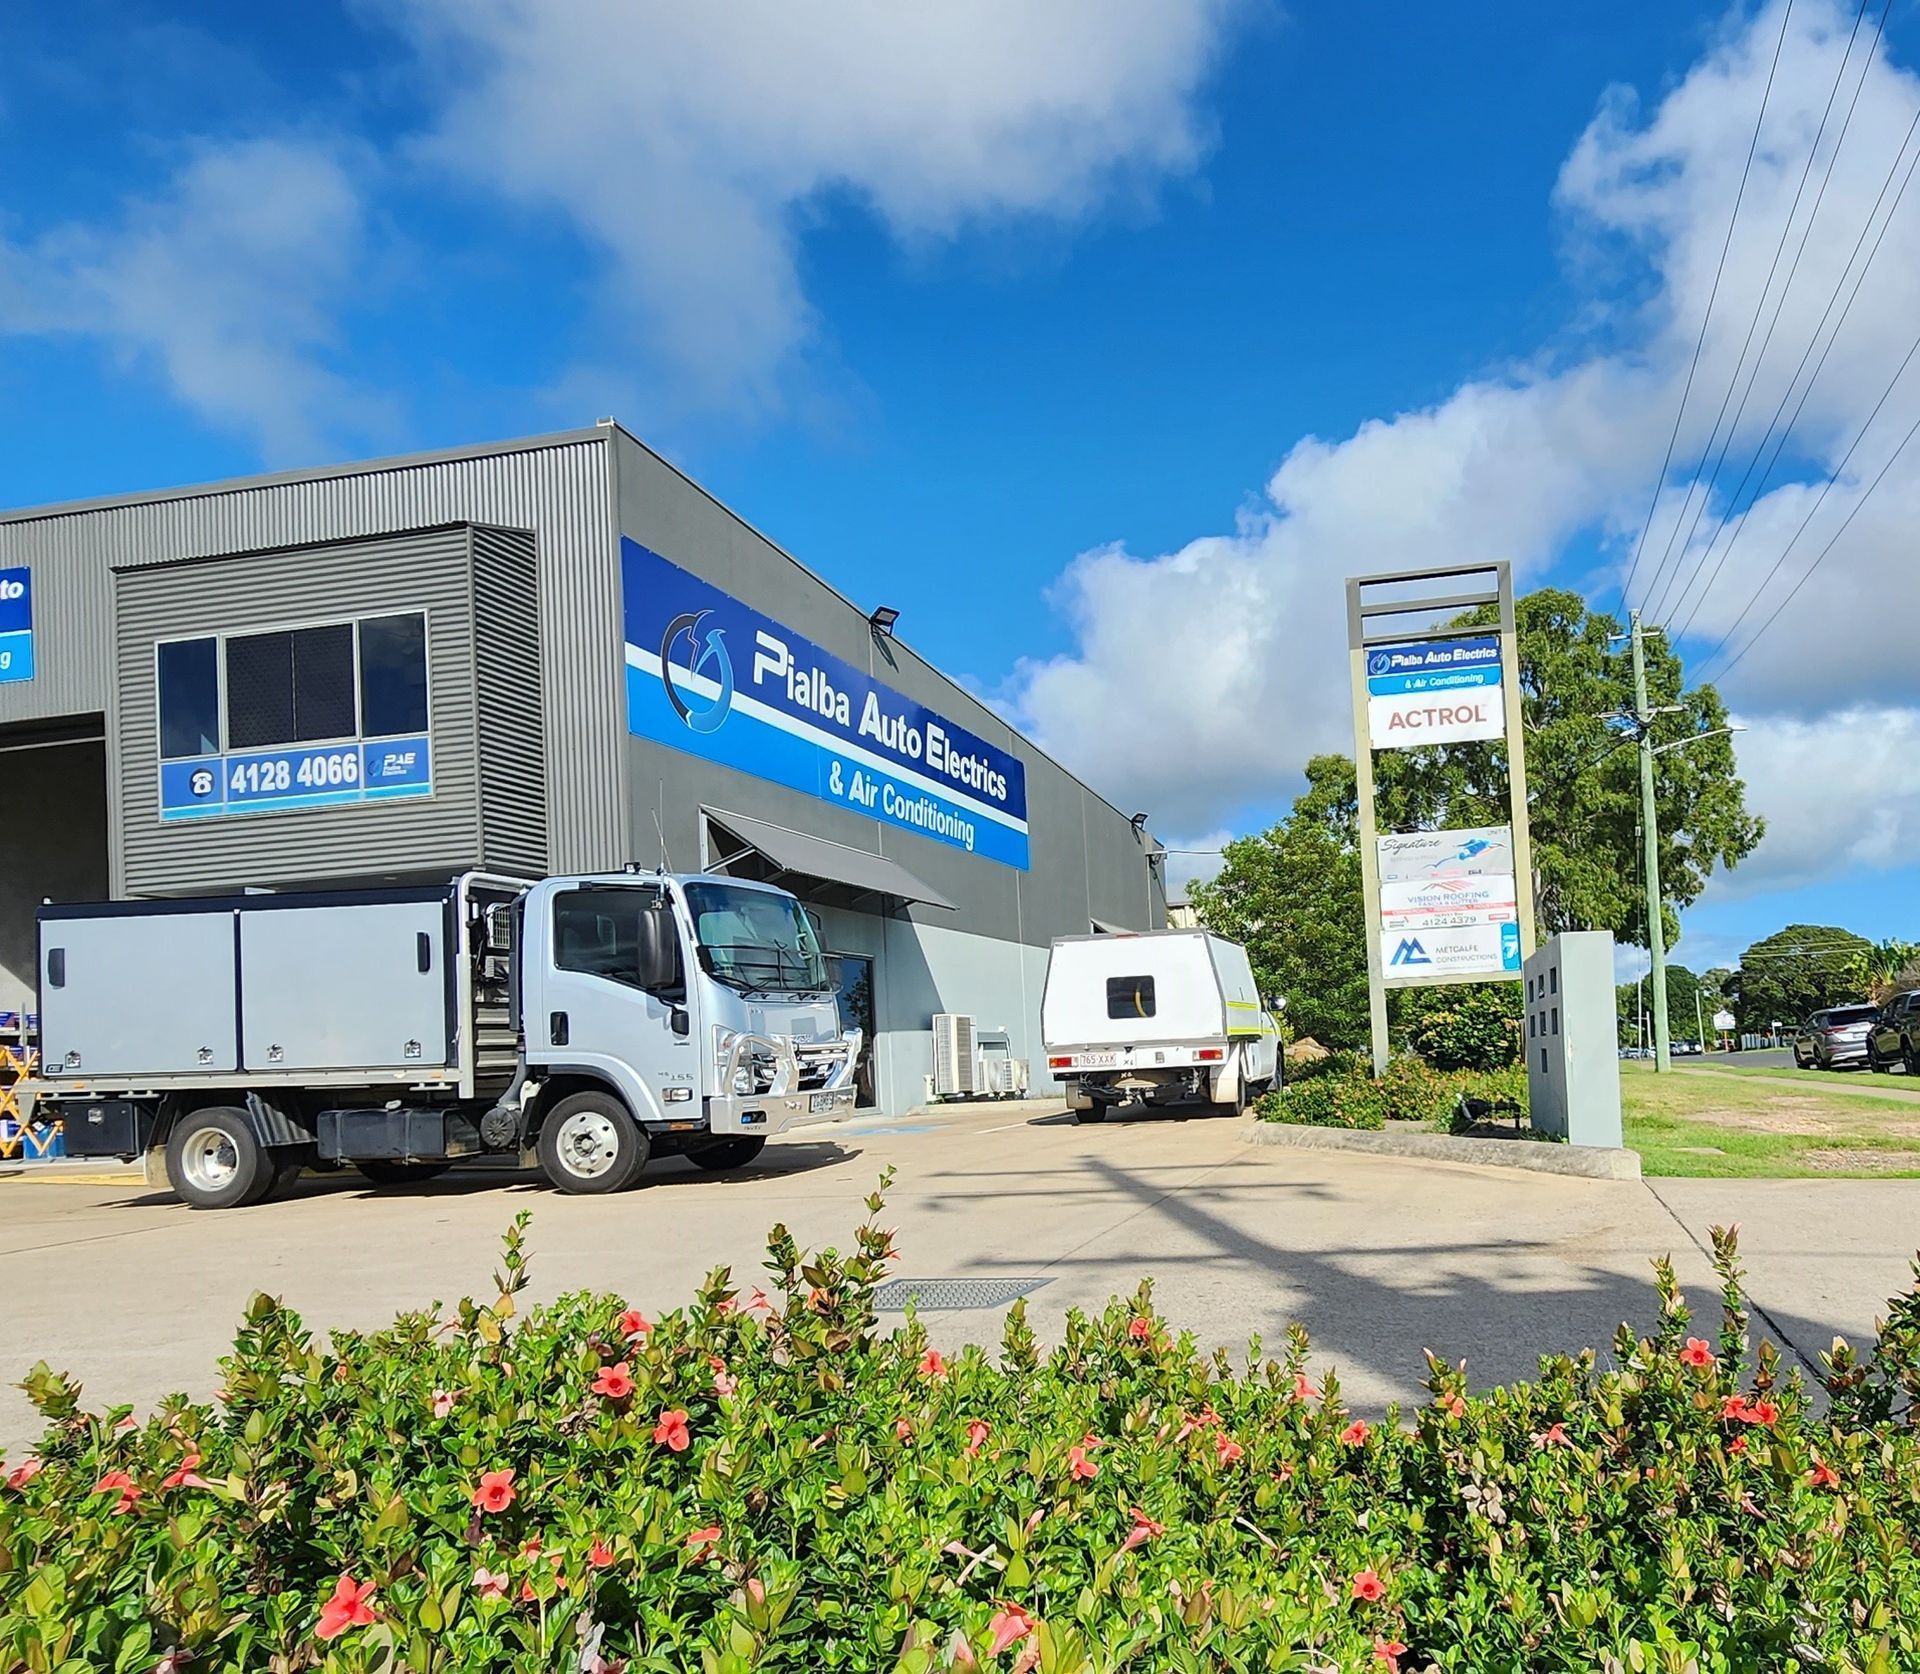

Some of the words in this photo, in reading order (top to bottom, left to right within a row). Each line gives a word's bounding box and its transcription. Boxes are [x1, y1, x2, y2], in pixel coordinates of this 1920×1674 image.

[1391, 654, 1423, 668] Pialba
[1425, 651, 1452, 665] Auto
[1453, 647, 1497, 661] Electrics
[1413, 679, 1428, 689] Air
[1429, 673, 1484, 686] Conditioning
[753, 630, 850, 727] Pialba
[858, 691, 922, 759] Auto
[926, 722, 1007, 801] Electrics
[1388, 704, 1488, 730] ACTROL
[384, 752, 416, 766] PAE
[230, 760, 290, 794] 4128
[296, 753, 358, 786] 4066
[829, 761, 844, 796] &
[849, 771, 878, 808] Air
[883, 783, 975, 851] Conditioning
[1380, 838, 1440, 855] Signature
[1407, 895, 1441, 904] VISION
[1443, 891, 1490, 901] ROOFING
[1422, 918, 1448, 927] 4124
[1450, 915, 1477, 925] 4379
[1435, 944, 1479, 954] METCALFE
[1436, 953, 1498, 964] CONSTRUCTIONS
